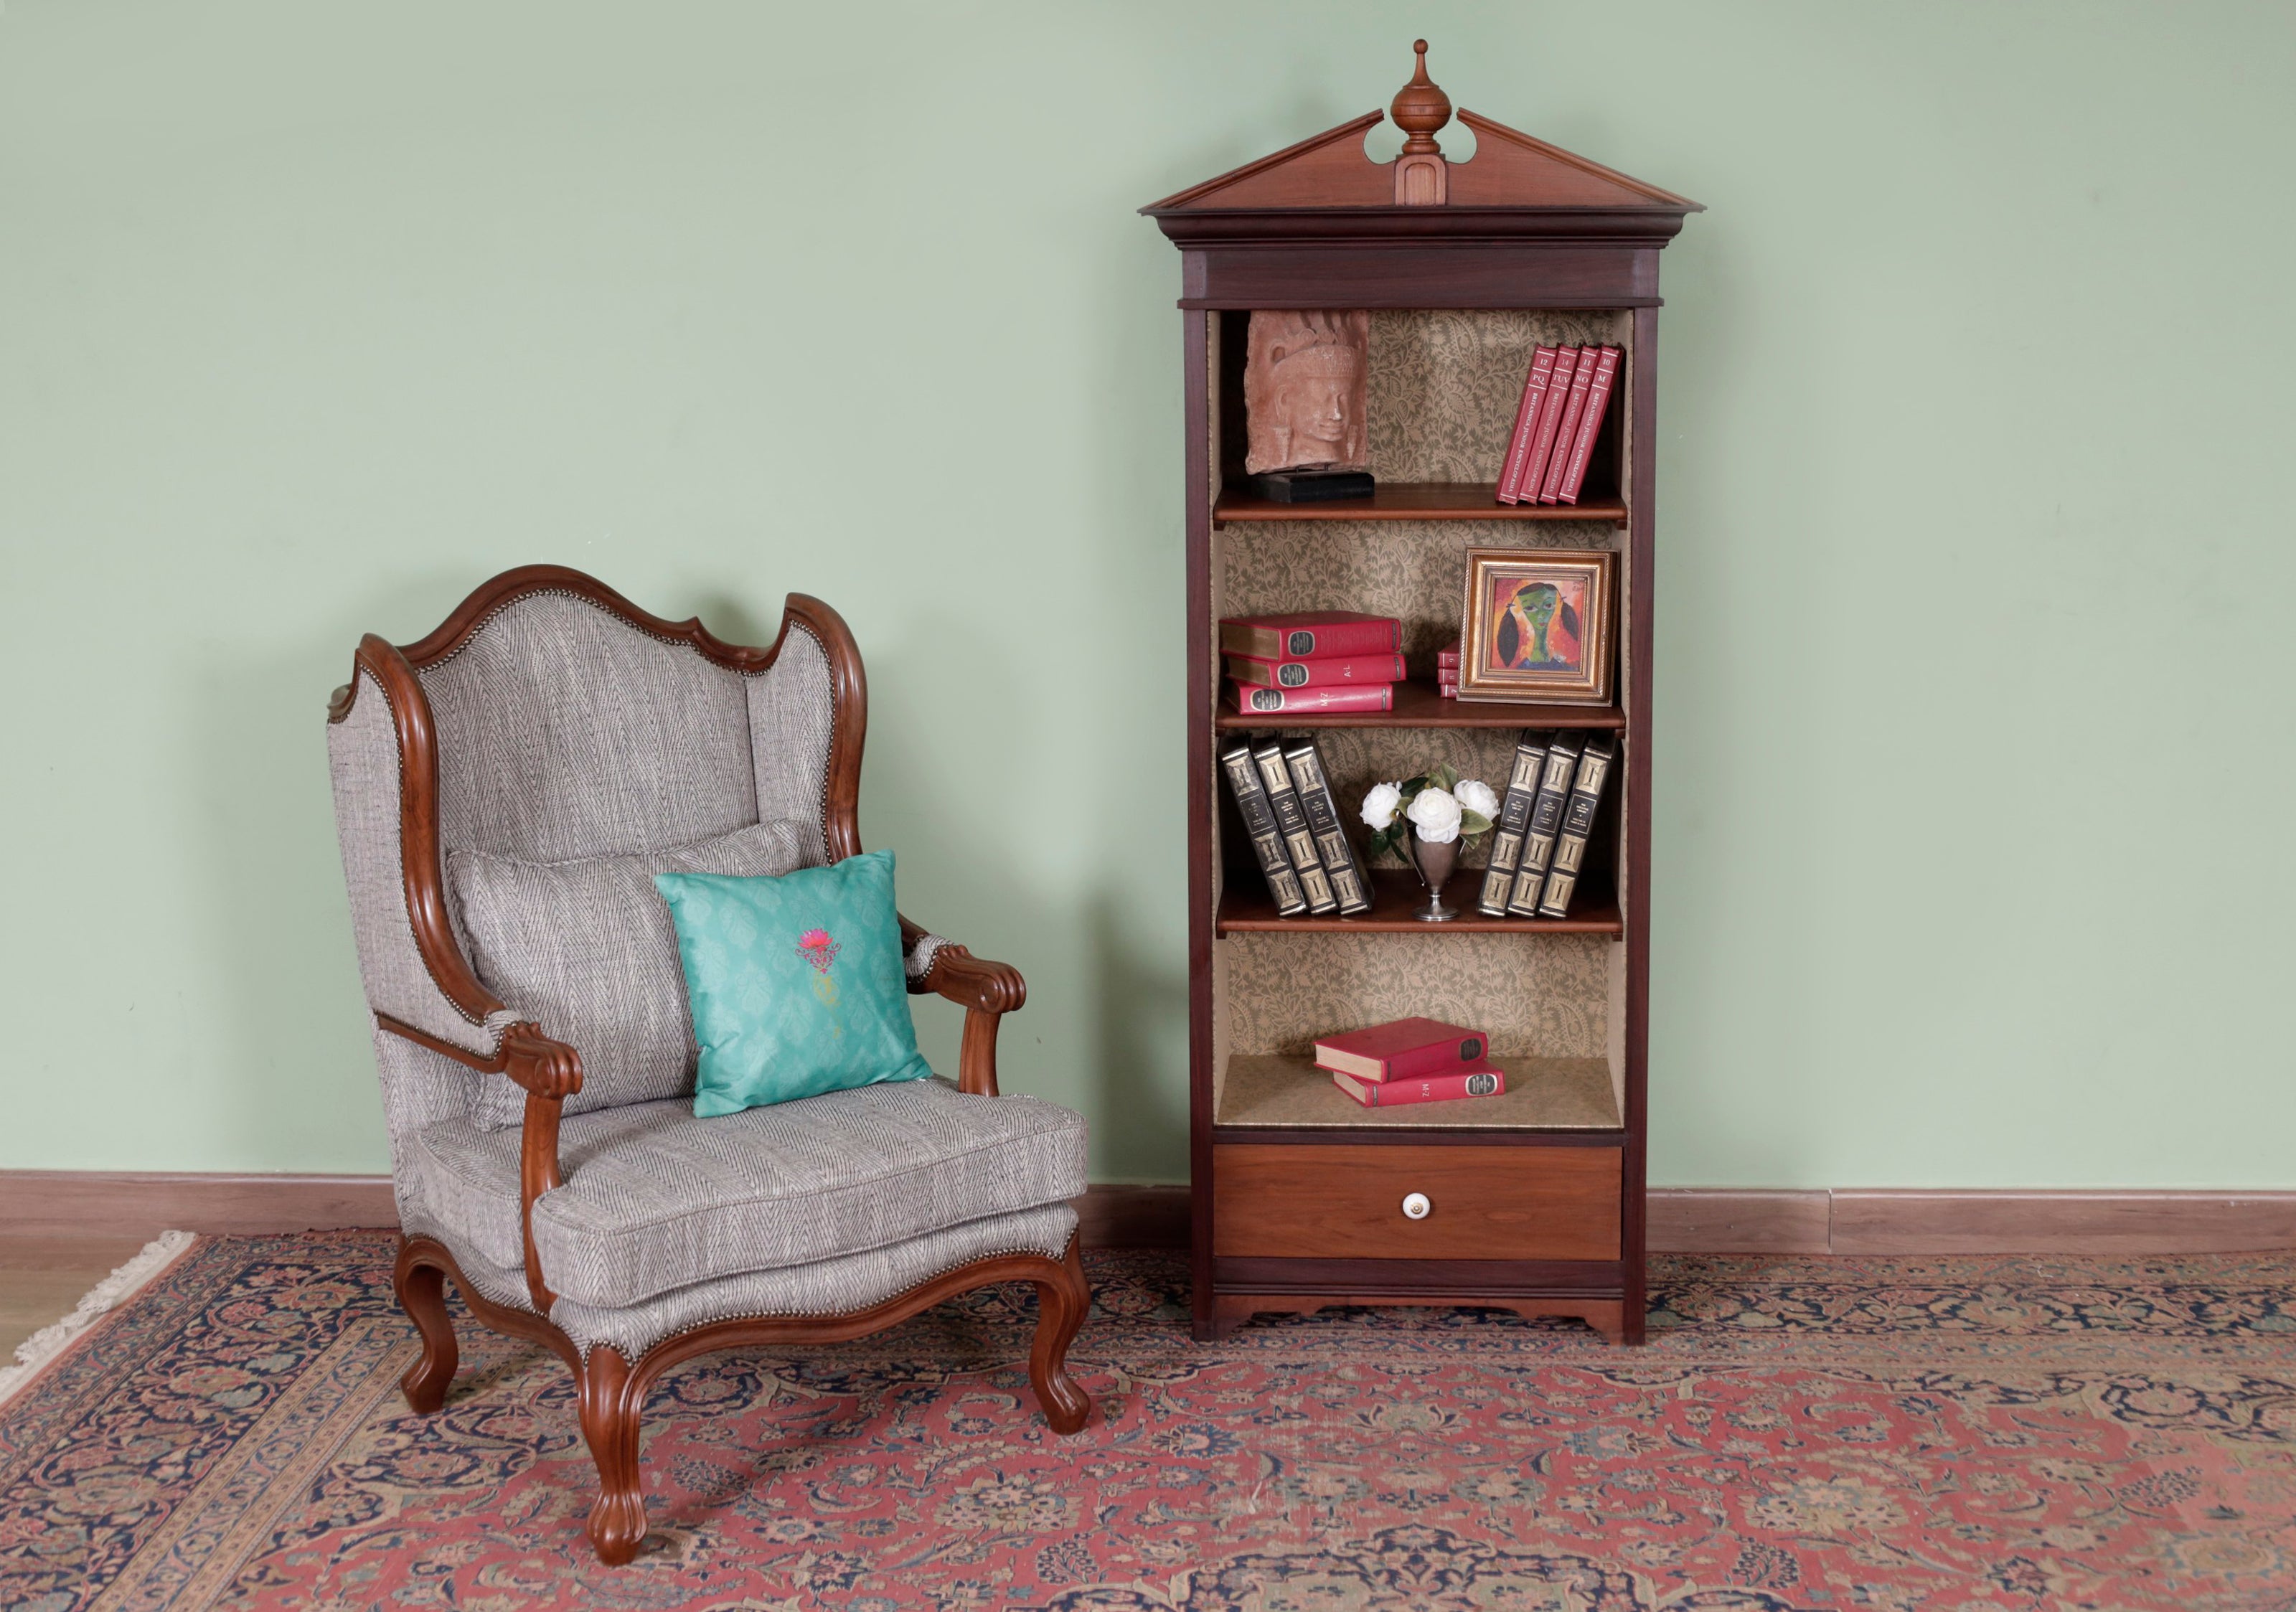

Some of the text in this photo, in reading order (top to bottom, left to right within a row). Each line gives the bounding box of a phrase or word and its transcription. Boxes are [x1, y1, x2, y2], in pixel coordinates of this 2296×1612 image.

[1533, 374, 1545, 385] PQ
[1553, 374, 1570, 384] TUV
[1576, 374, 1589, 383] NO
[1525, 392, 1538, 429] BRITANNICA
[1546, 392, 1559, 429] BRITANNICA
[1567, 392, 1580, 429] BRITANNICA
[1586, 392, 1600, 428] BRITANNICA
[1520, 426, 1529, 448] JUNIOR
[1540, 426, 1550, 448] JUNIOR
[1561, 426, 1571, 448] JUNIOR
[1580, 426, 1590, 448] JUNIOR
